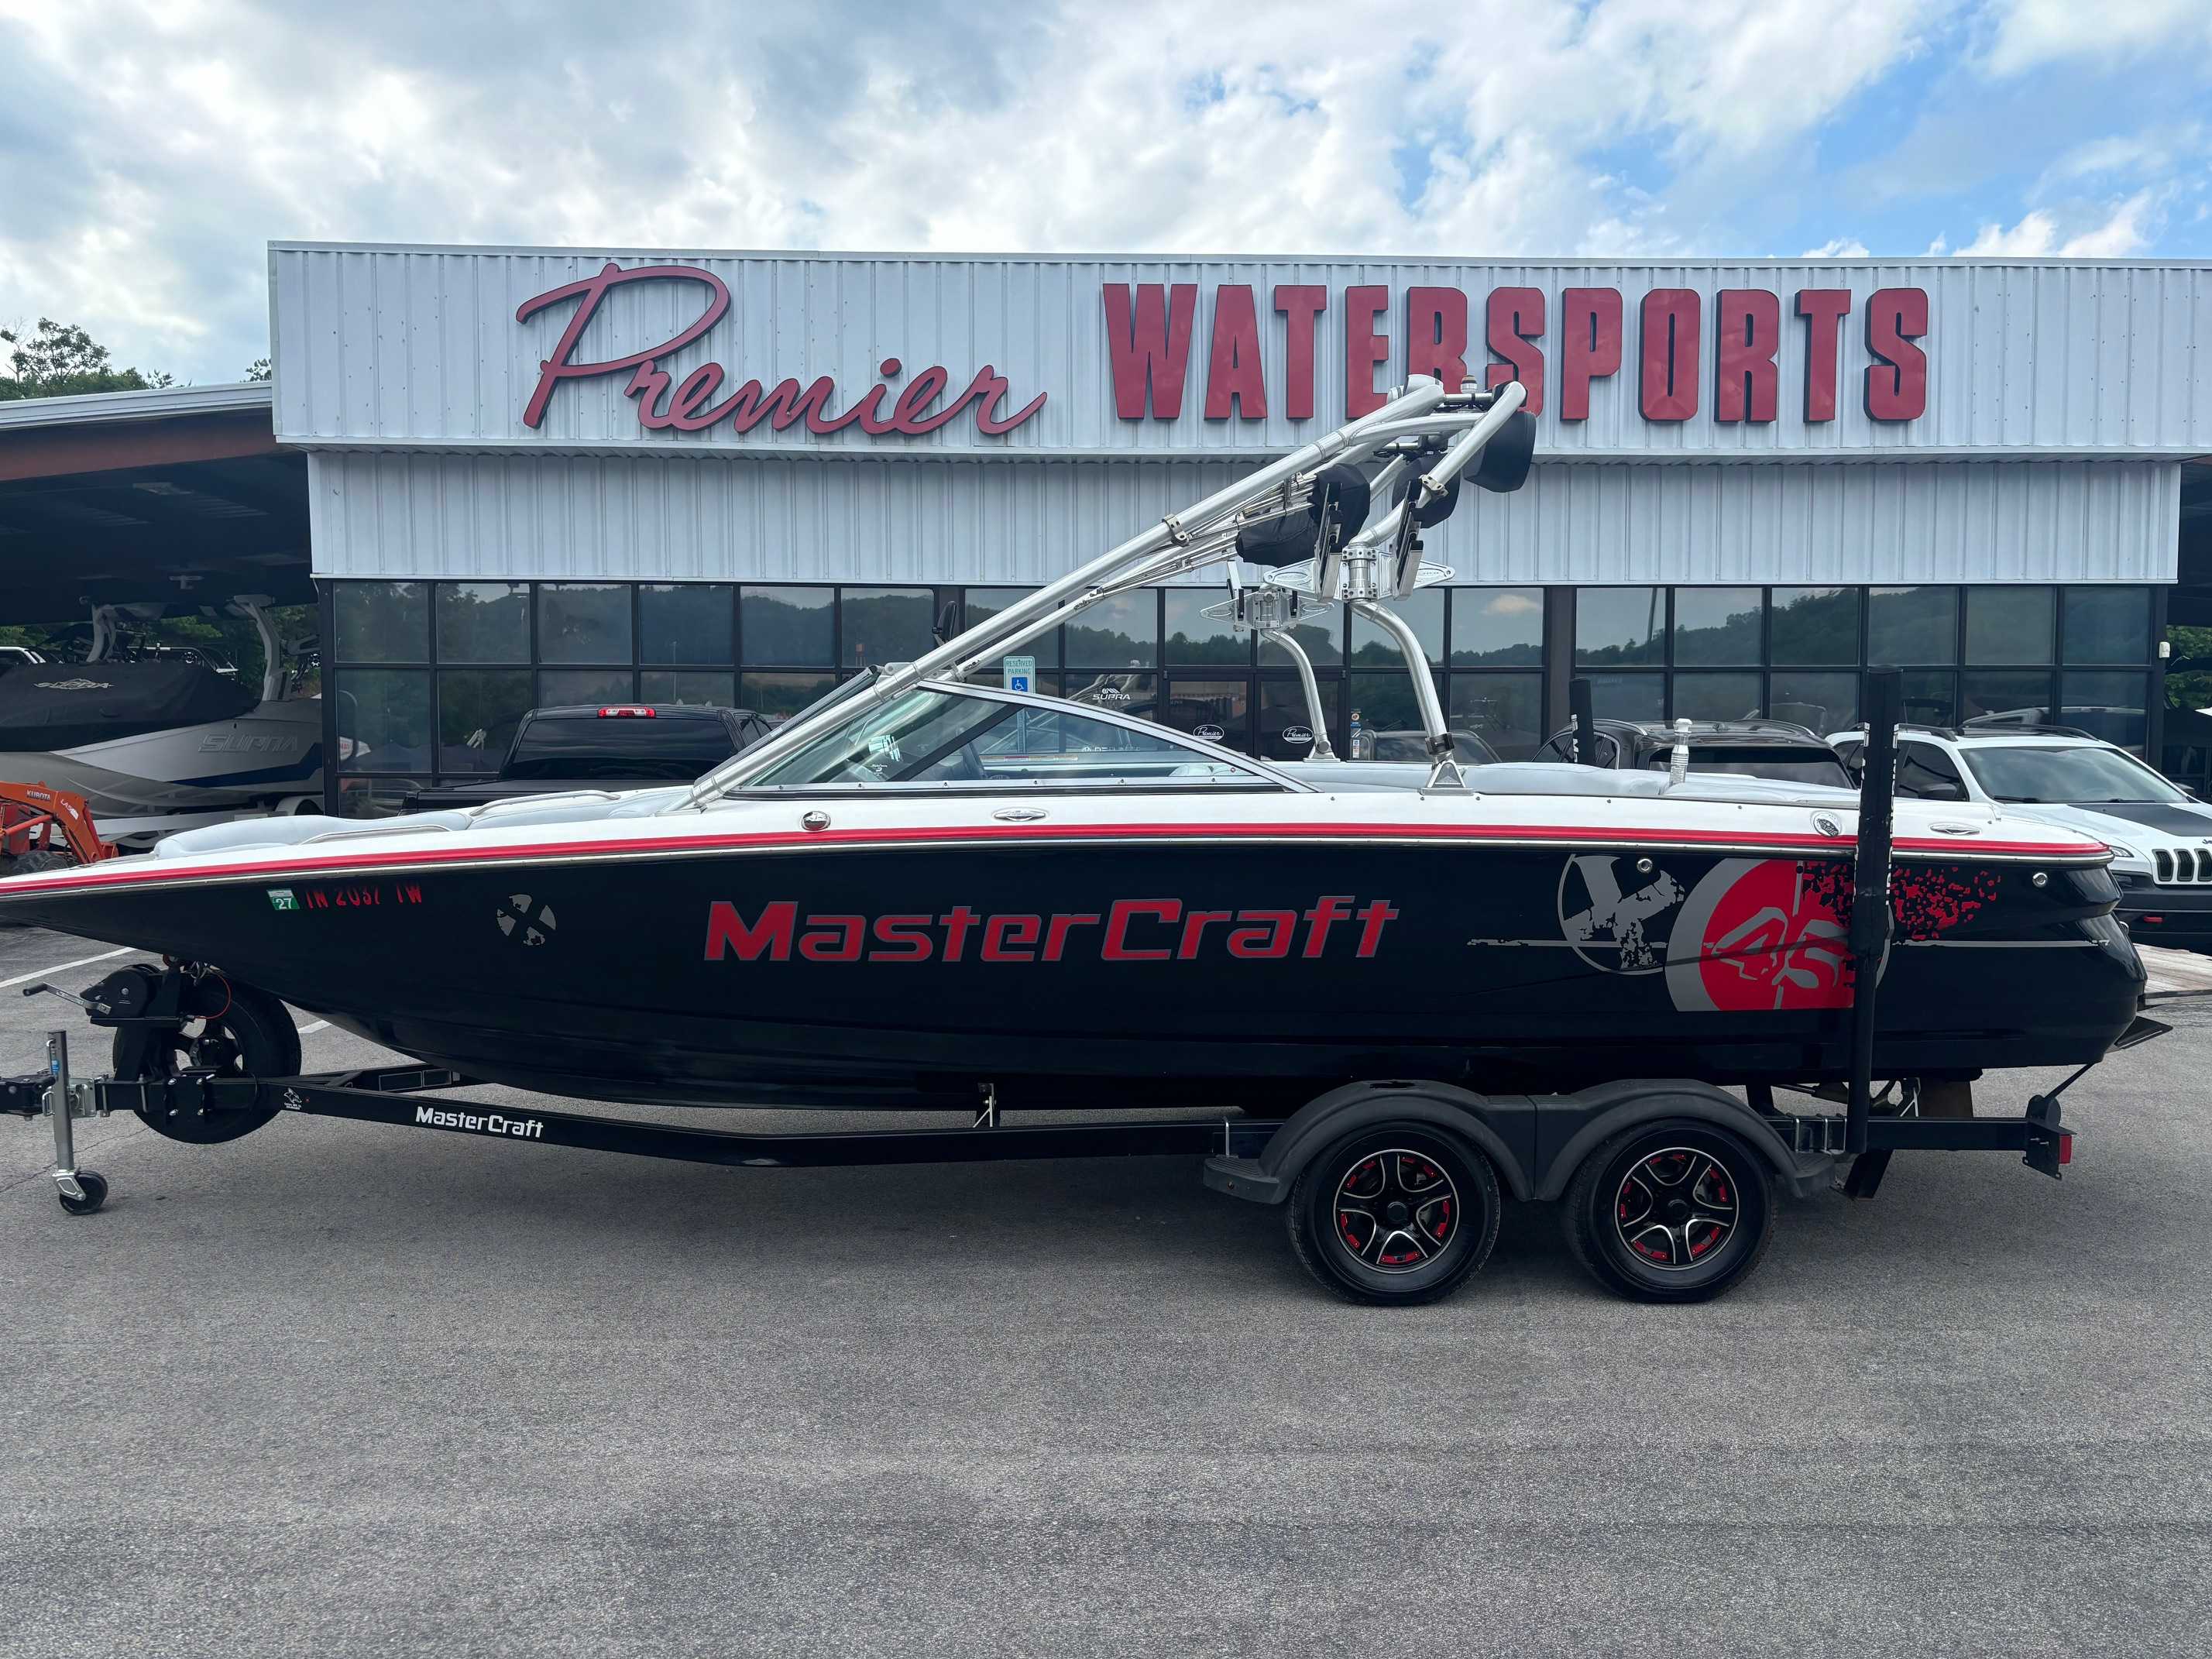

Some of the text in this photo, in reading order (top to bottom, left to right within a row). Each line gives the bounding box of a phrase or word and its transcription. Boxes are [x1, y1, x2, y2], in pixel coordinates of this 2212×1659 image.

[516, 263, 1929, 434] Premier WATERSPORTS
[26, 789, 51, 801] KUBOTA
[276, 898, 293, 910] 27
[703, 895, 1400, 963] MasterCraft
[415, 1106, 544, 1138] MasterCraft
